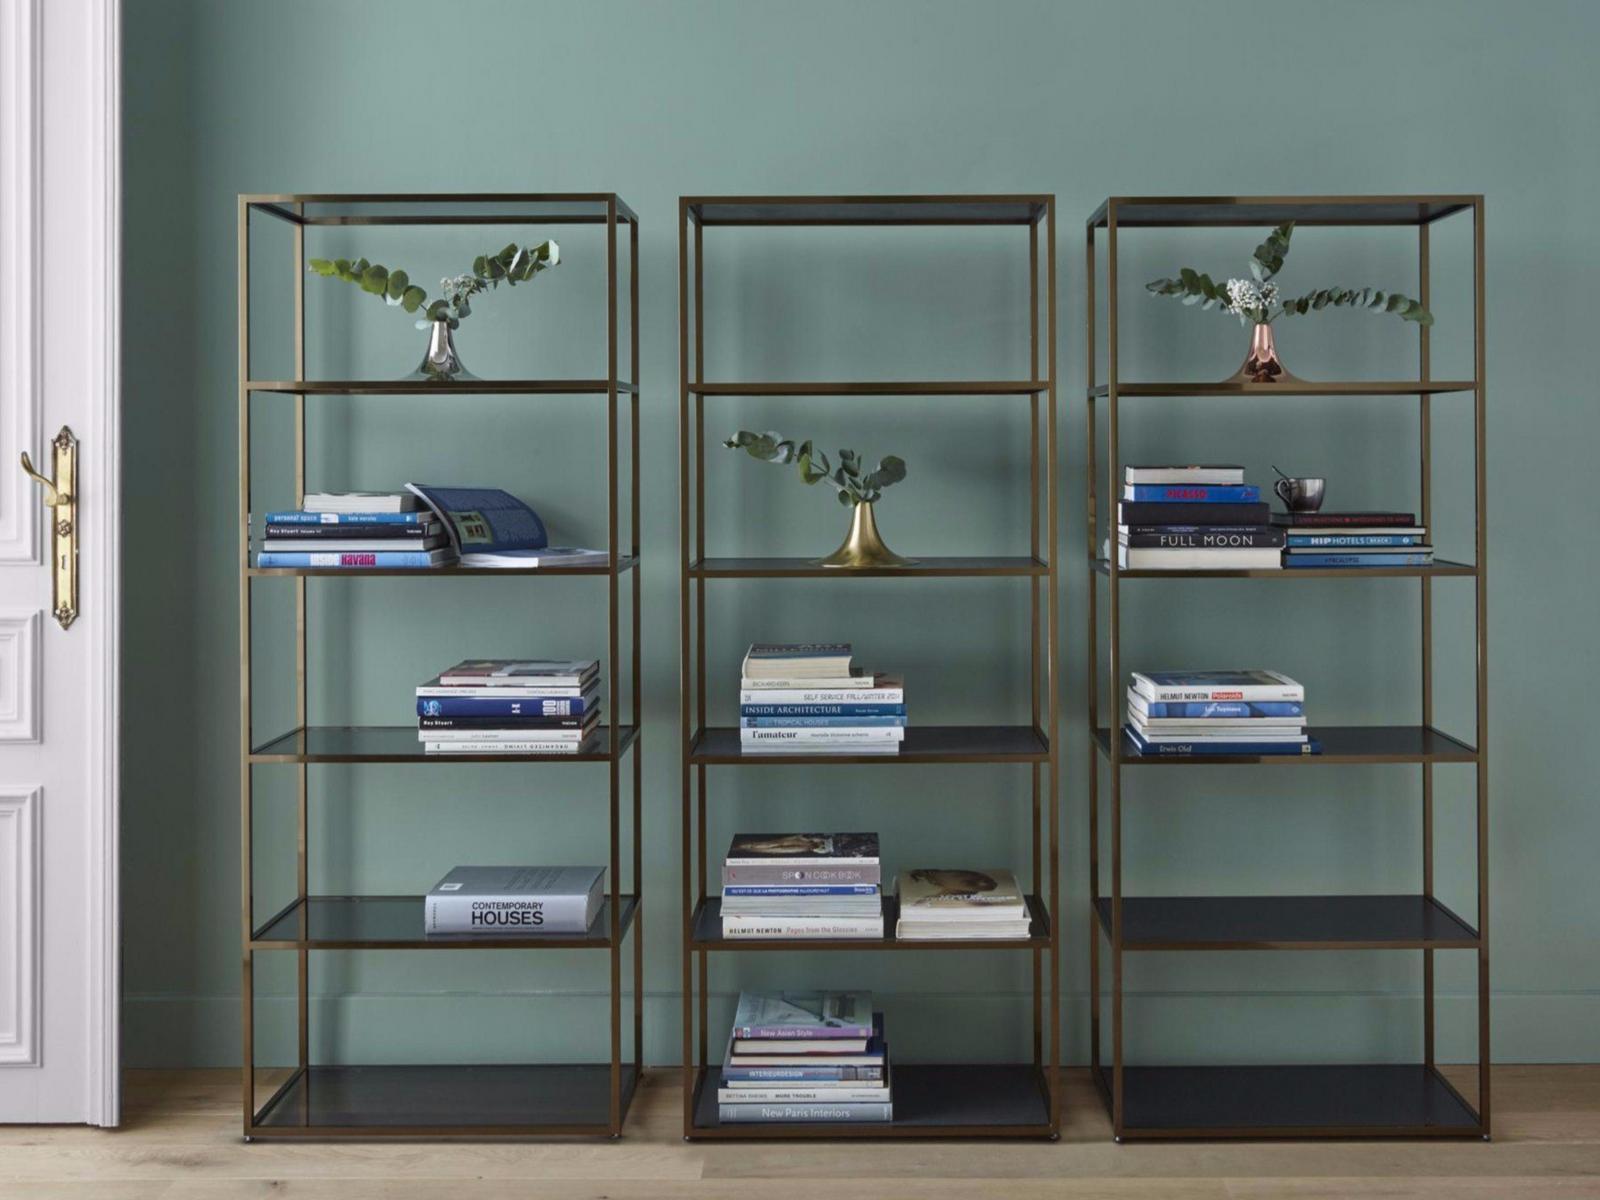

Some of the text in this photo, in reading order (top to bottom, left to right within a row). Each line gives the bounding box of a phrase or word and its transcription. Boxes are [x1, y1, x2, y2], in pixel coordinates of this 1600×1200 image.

[1160, 535, 1253, 546] FULL MOON
[1332, 536, 1365, 545] HOTELS
[1160, 692, 1183, 700] HELMUT
[1184, 692, 1209, 700] NEWTON
[745, 705, 841, 714] INSIDE ARCHITECTURE
[472, 901, 544, 910] CONTEMPORARY
[471, 911, 544, 926] HOUSES
[760, 1029, 776, 1037] New
[761, 1107, 850, 1118] New Paris Interiors
